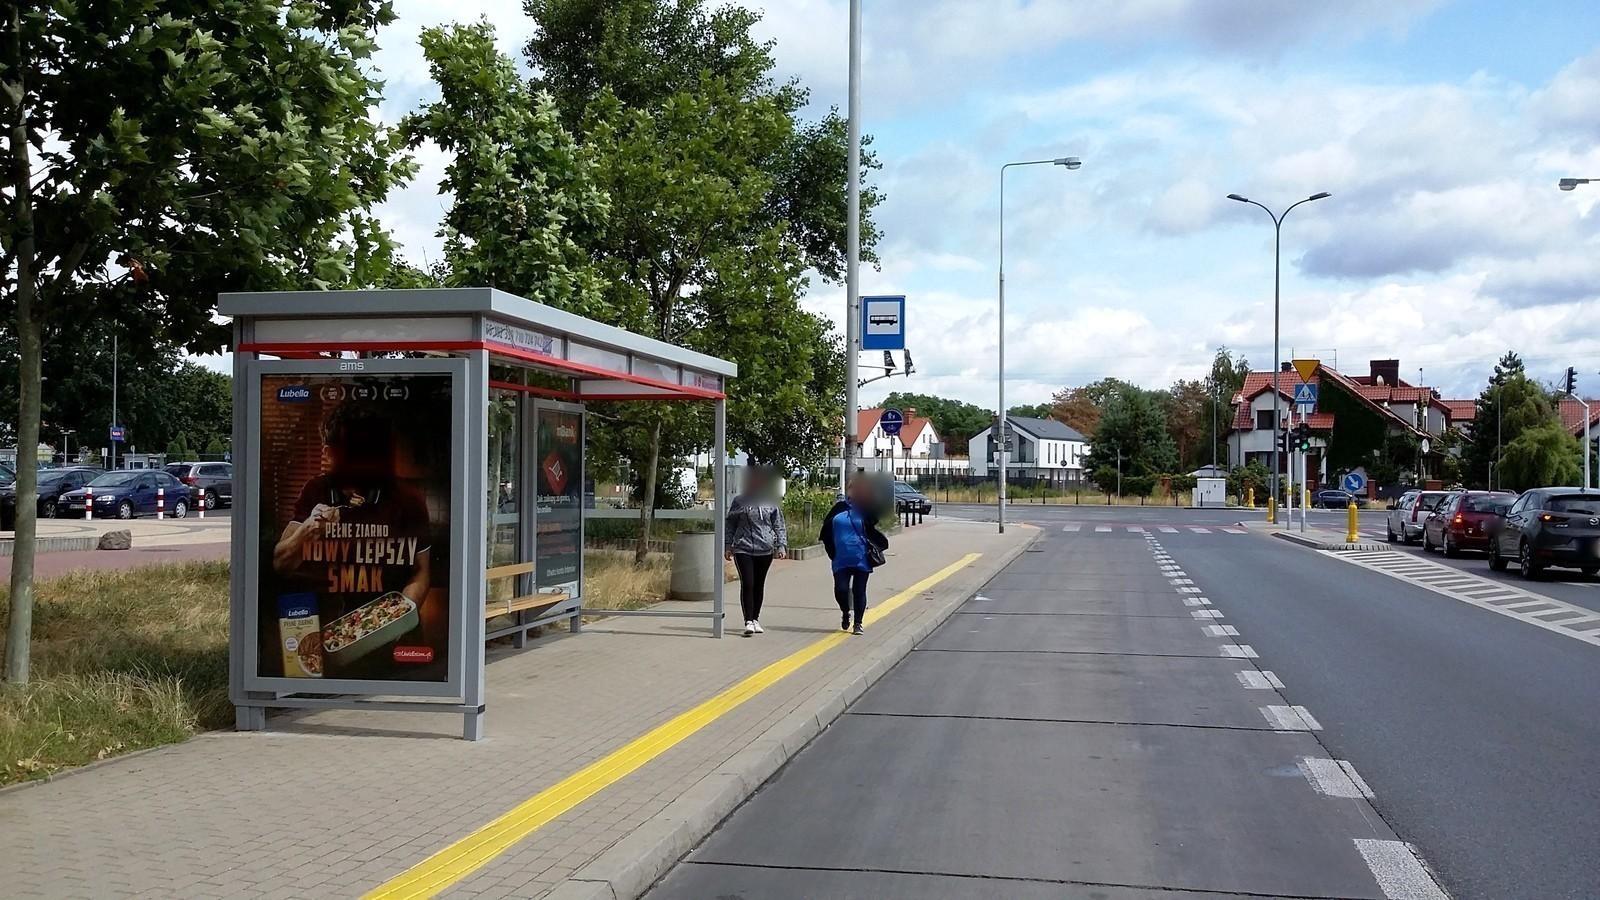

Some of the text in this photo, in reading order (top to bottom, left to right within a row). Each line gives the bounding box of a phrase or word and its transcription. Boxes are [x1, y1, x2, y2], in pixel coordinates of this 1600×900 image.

[340, 362, 365, 371] ams
[279, 388, 310, 398] Lubella
[325, 522, 389, 538] PEŁNE ZIARNO
[302, 537, 417, 565] NOWY LEPSZY
[328, 565, 384, 592] SMAK
